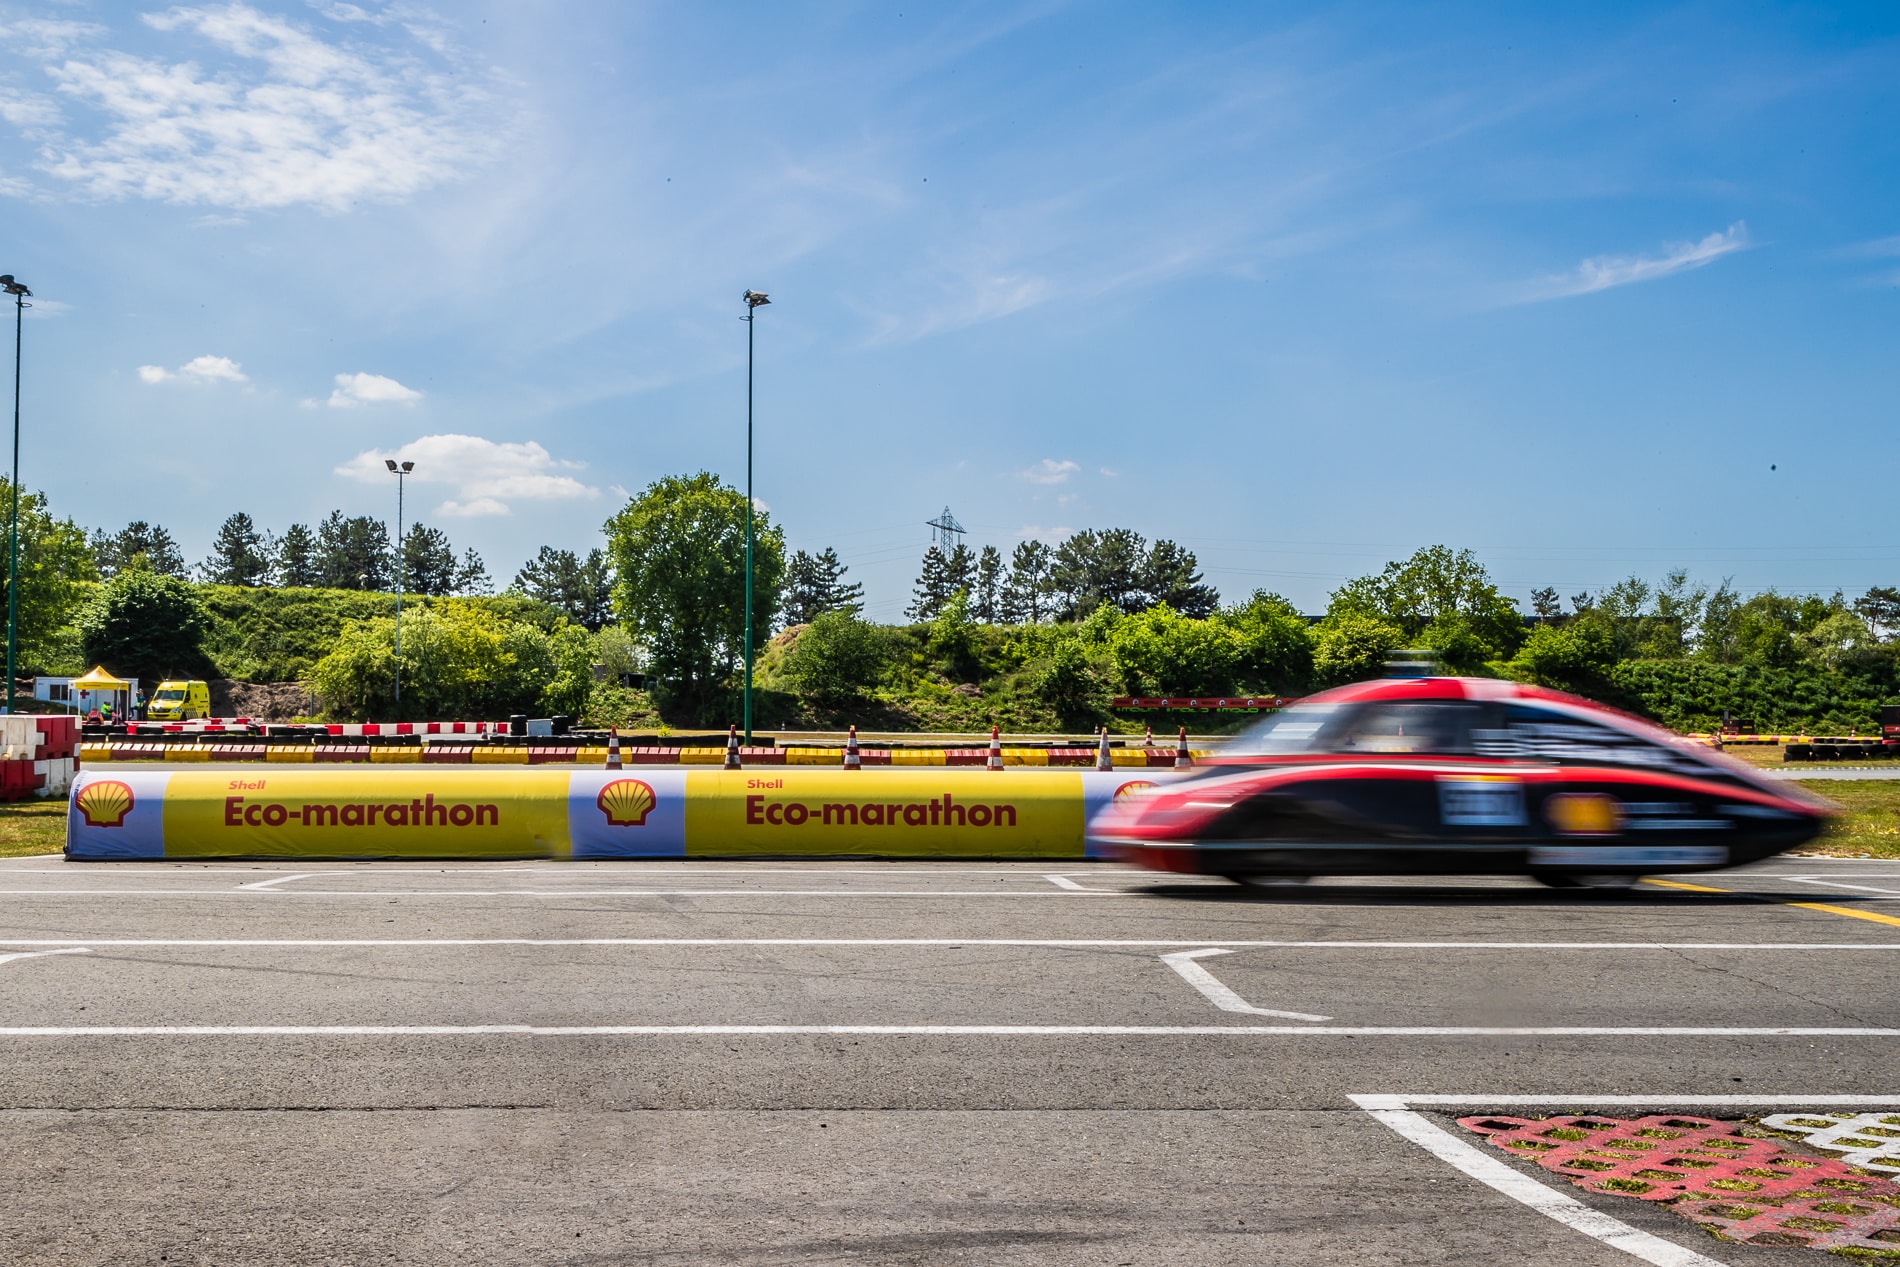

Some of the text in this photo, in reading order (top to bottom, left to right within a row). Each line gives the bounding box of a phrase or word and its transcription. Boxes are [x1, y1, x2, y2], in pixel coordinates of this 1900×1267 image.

[229, 780, 266, 790] Shell
[747, 779, 783, 789] Shell
[225, 793, 498, 826] Eco-marathon
[747, 793, 1016, 826] Eco-marathon
